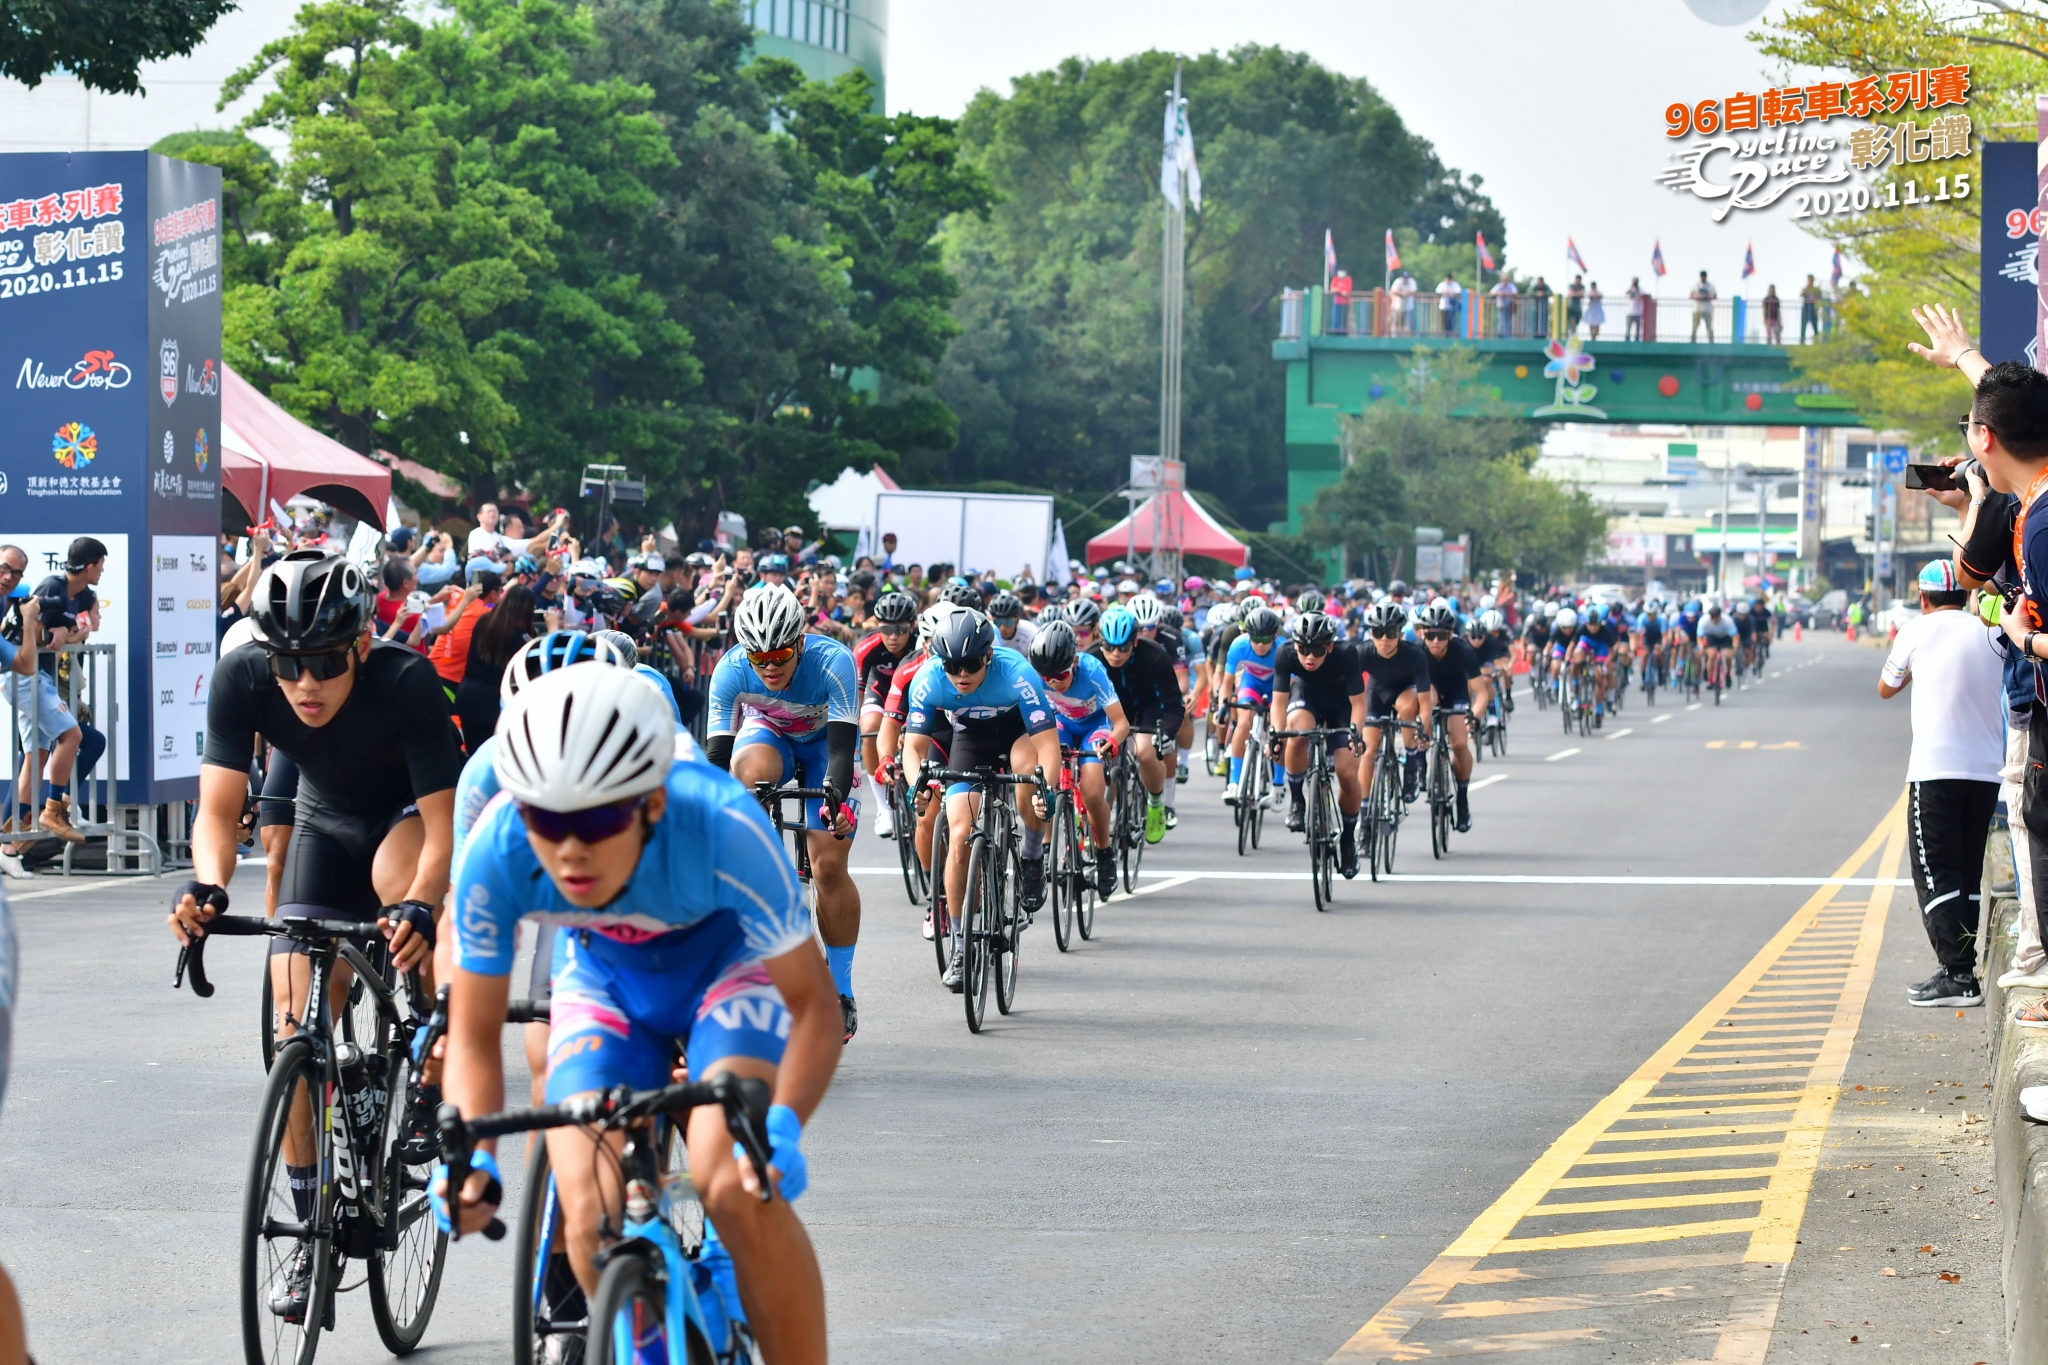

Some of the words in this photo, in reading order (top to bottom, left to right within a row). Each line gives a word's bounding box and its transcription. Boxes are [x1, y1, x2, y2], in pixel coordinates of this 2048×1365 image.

[0, 183, 123, 233] 車系列賽
[0, 261, 124, 299] 2020.11.15
[309, 963, 323, 1019] LOOK
